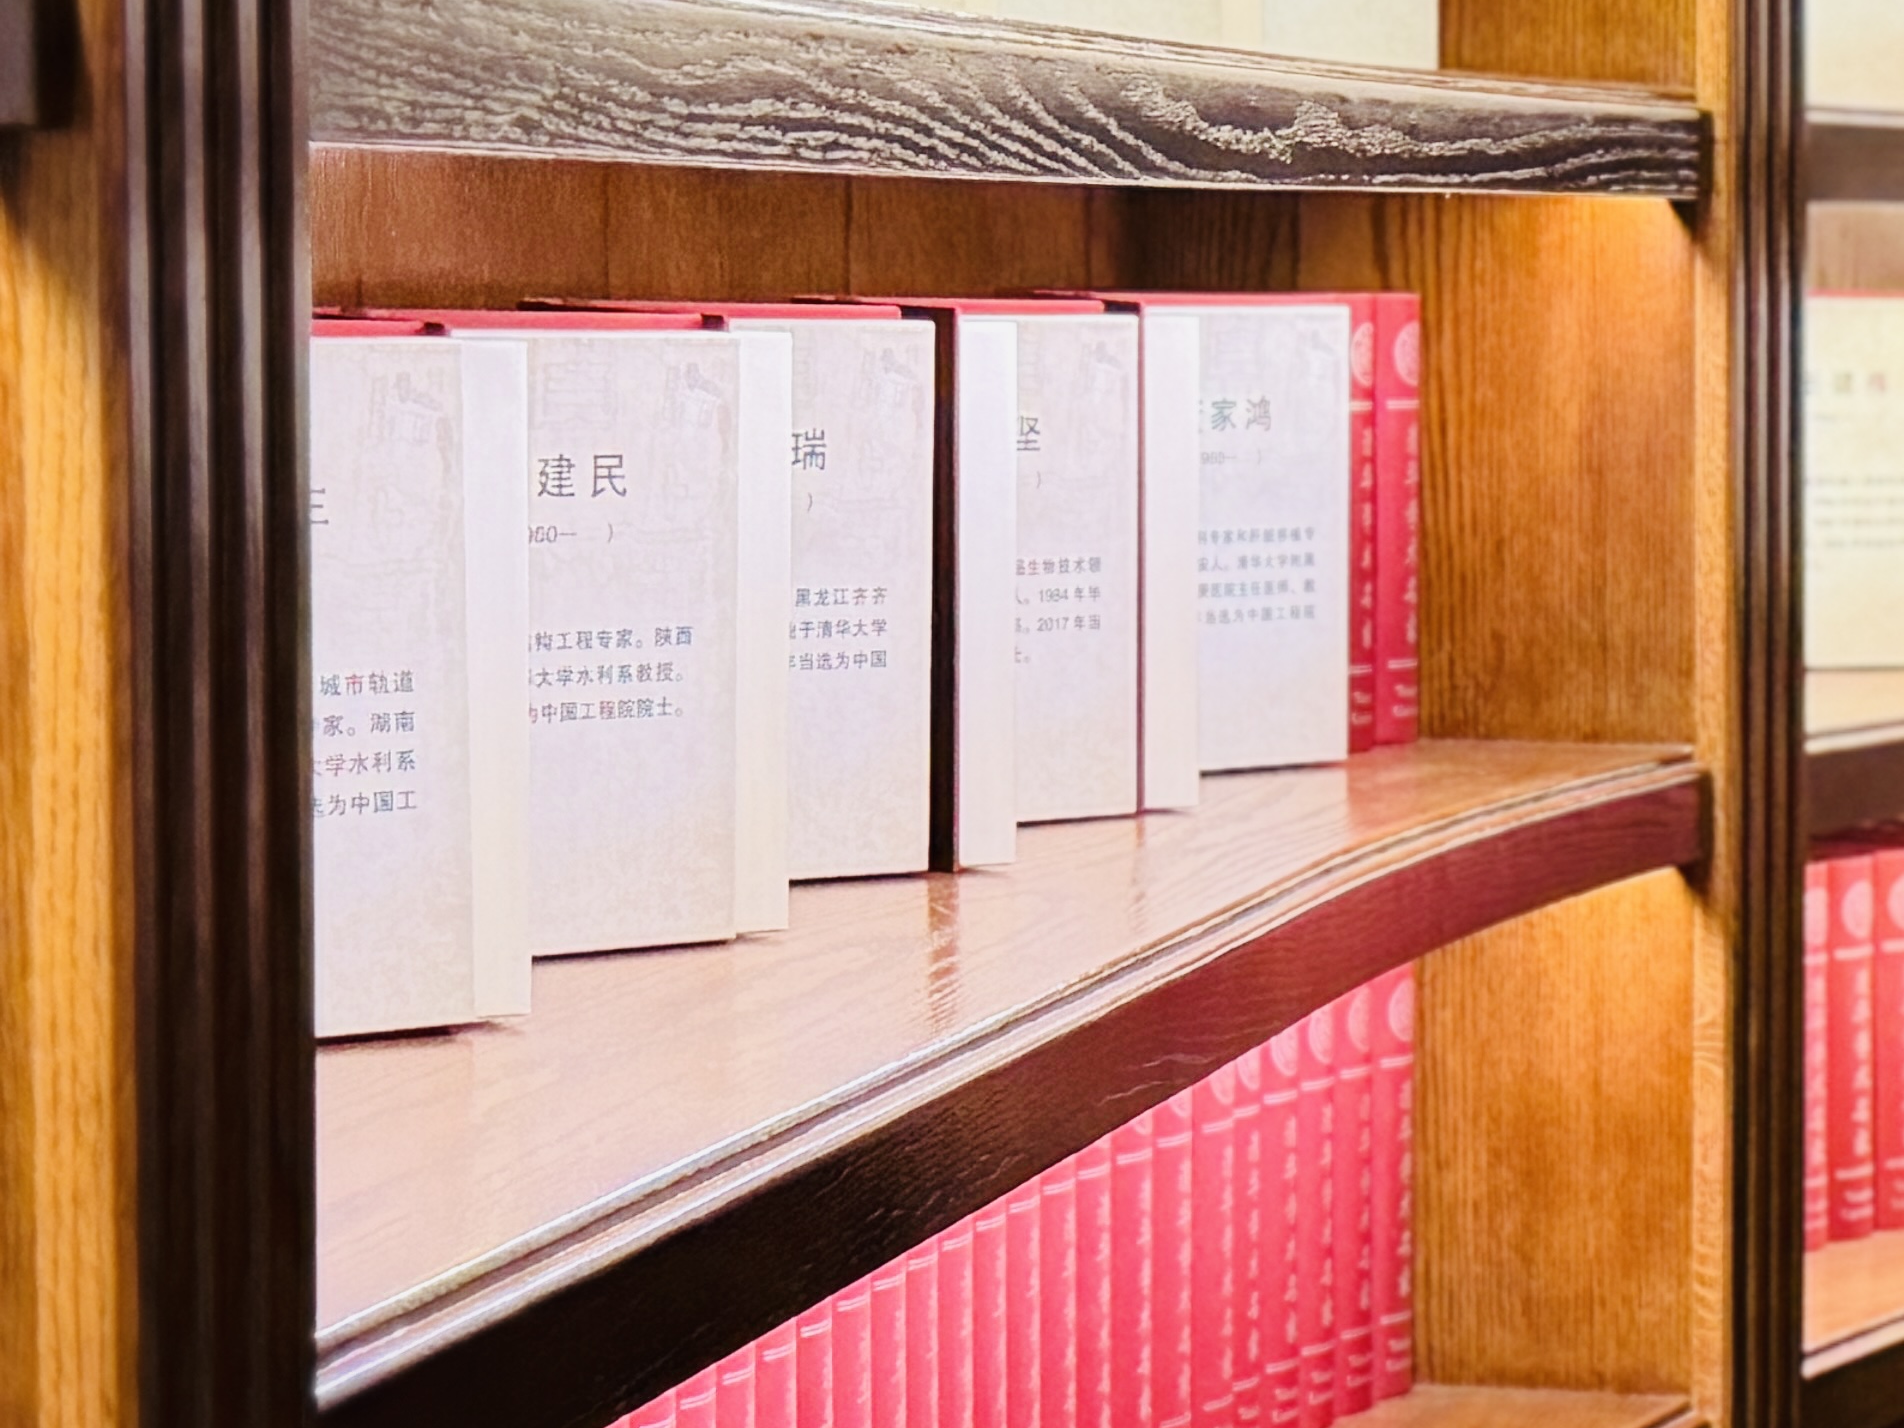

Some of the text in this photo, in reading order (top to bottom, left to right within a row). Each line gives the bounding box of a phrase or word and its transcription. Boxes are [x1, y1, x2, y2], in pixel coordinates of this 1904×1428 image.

[1199, 395, 1272, 435] 家鸿
[791, 427, 827, 471] 瑞
[537, 453, 627, 499] 建民
[795, 586, 888, 608] 黑龙江齐齐
[1197, 603, 1316, 625] 当选为中国工程院
[320, 670, 415, 698] 城市轨道
[528, 661, 684, 687] 大学水利系教授。
